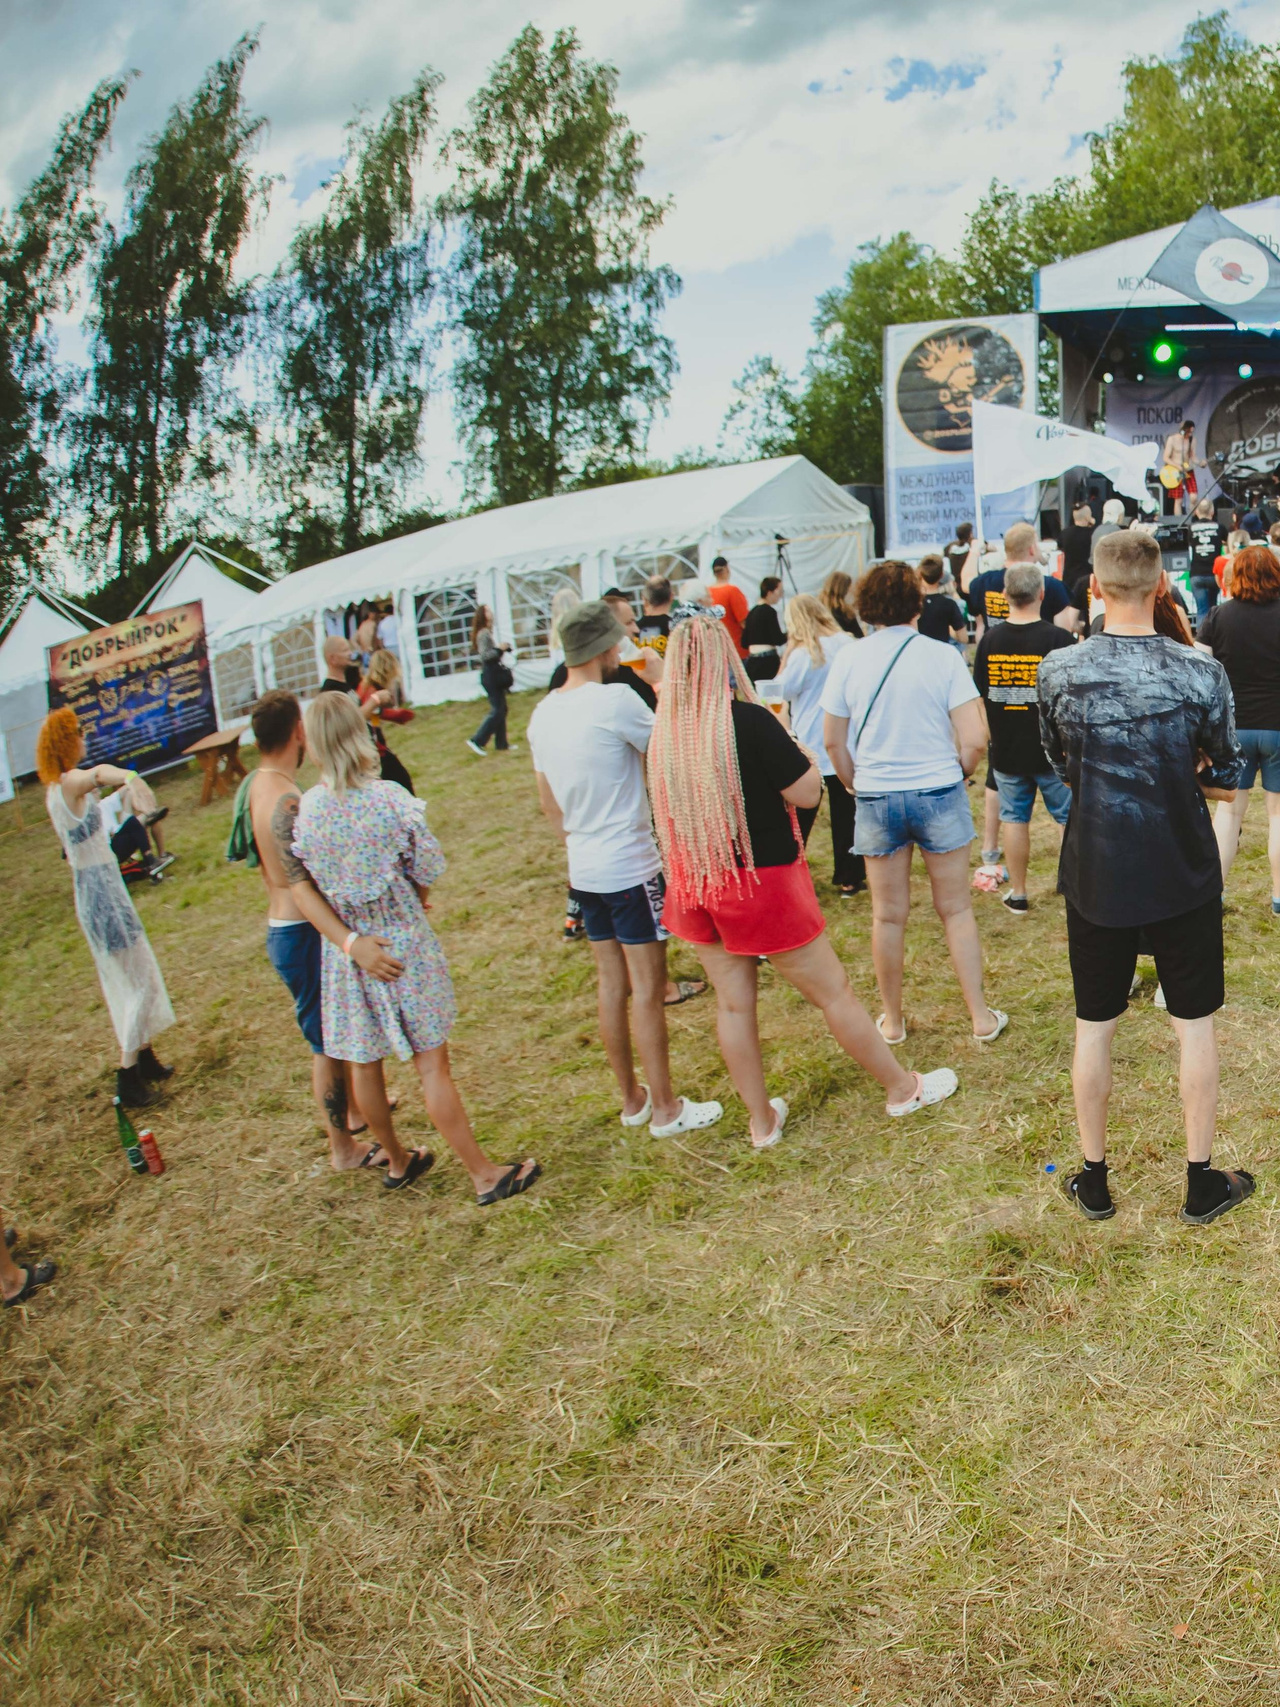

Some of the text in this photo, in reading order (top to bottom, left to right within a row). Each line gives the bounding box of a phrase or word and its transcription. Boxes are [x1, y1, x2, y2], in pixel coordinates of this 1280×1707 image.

[1136, 406, 1183, 425] ПСКОВ
[899, 489, 966, 507] ФЕСТИВАЛЬ
[942, 505, 992, 522] МУЗЫИ
